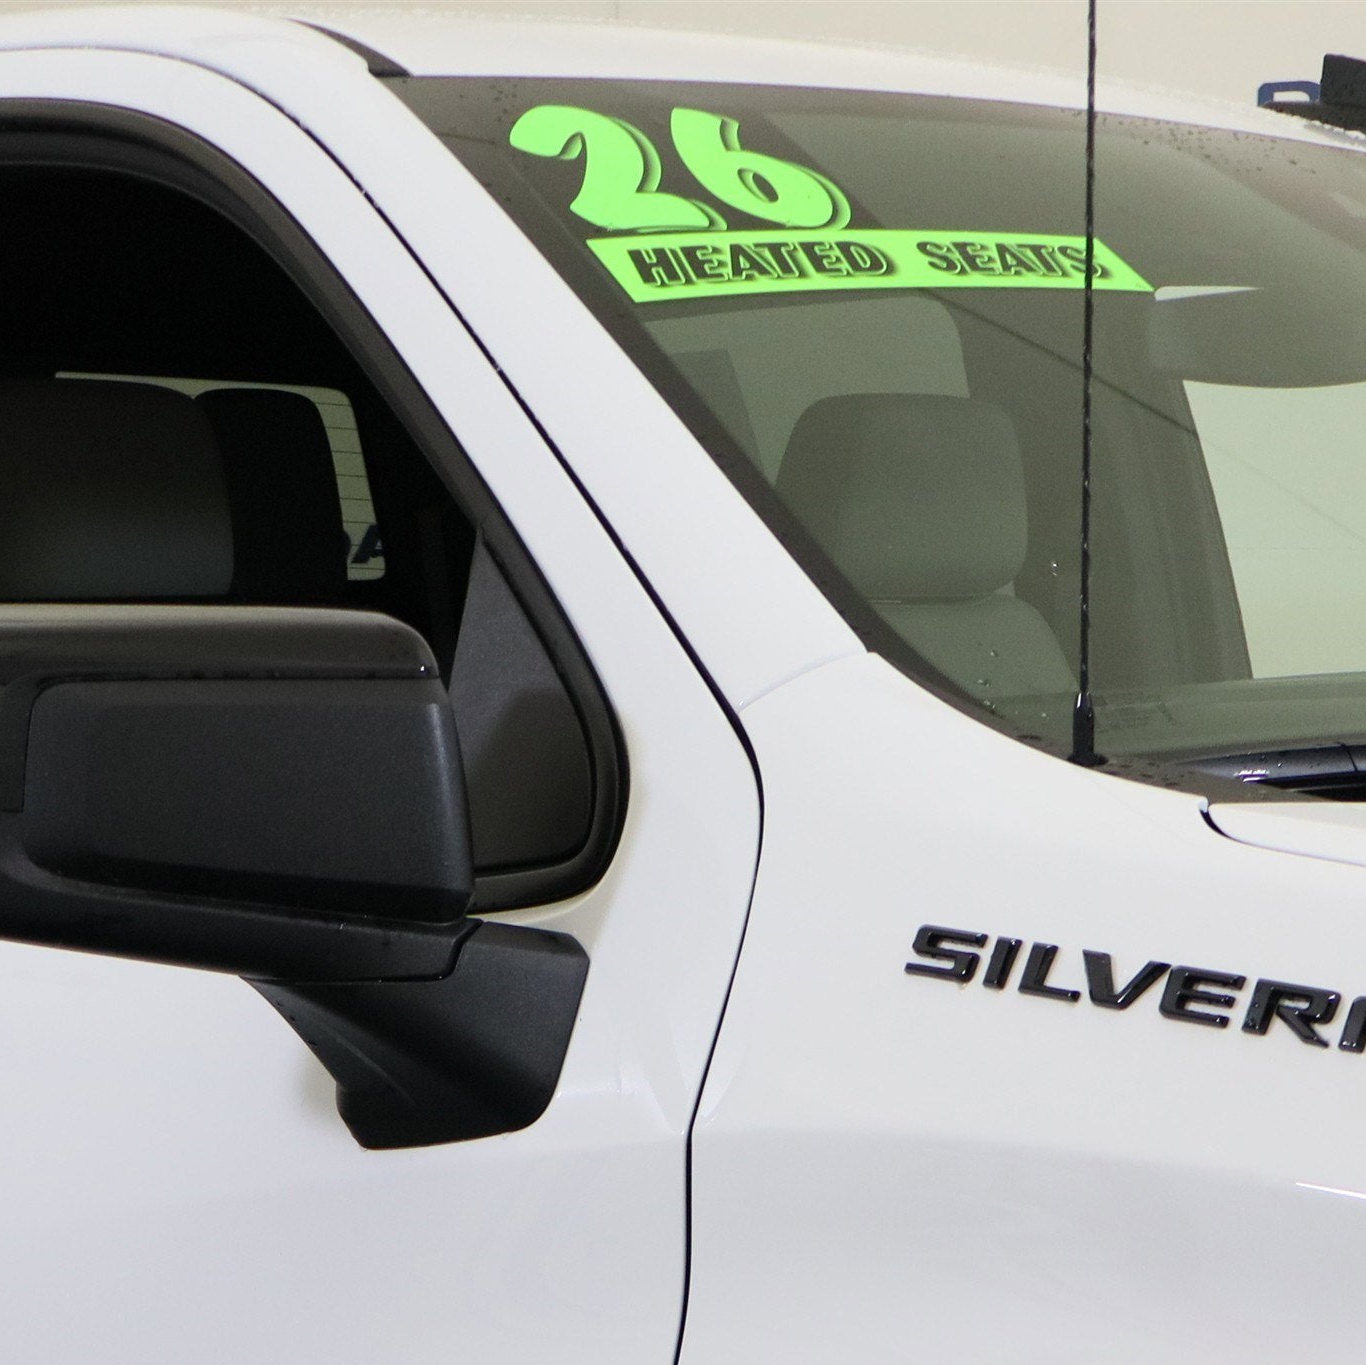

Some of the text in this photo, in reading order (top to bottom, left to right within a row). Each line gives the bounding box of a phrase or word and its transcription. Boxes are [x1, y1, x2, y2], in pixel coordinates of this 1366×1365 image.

[510, 105, 849, 231] 26
[627, 241, 1109, 288] HEATED SEATS
